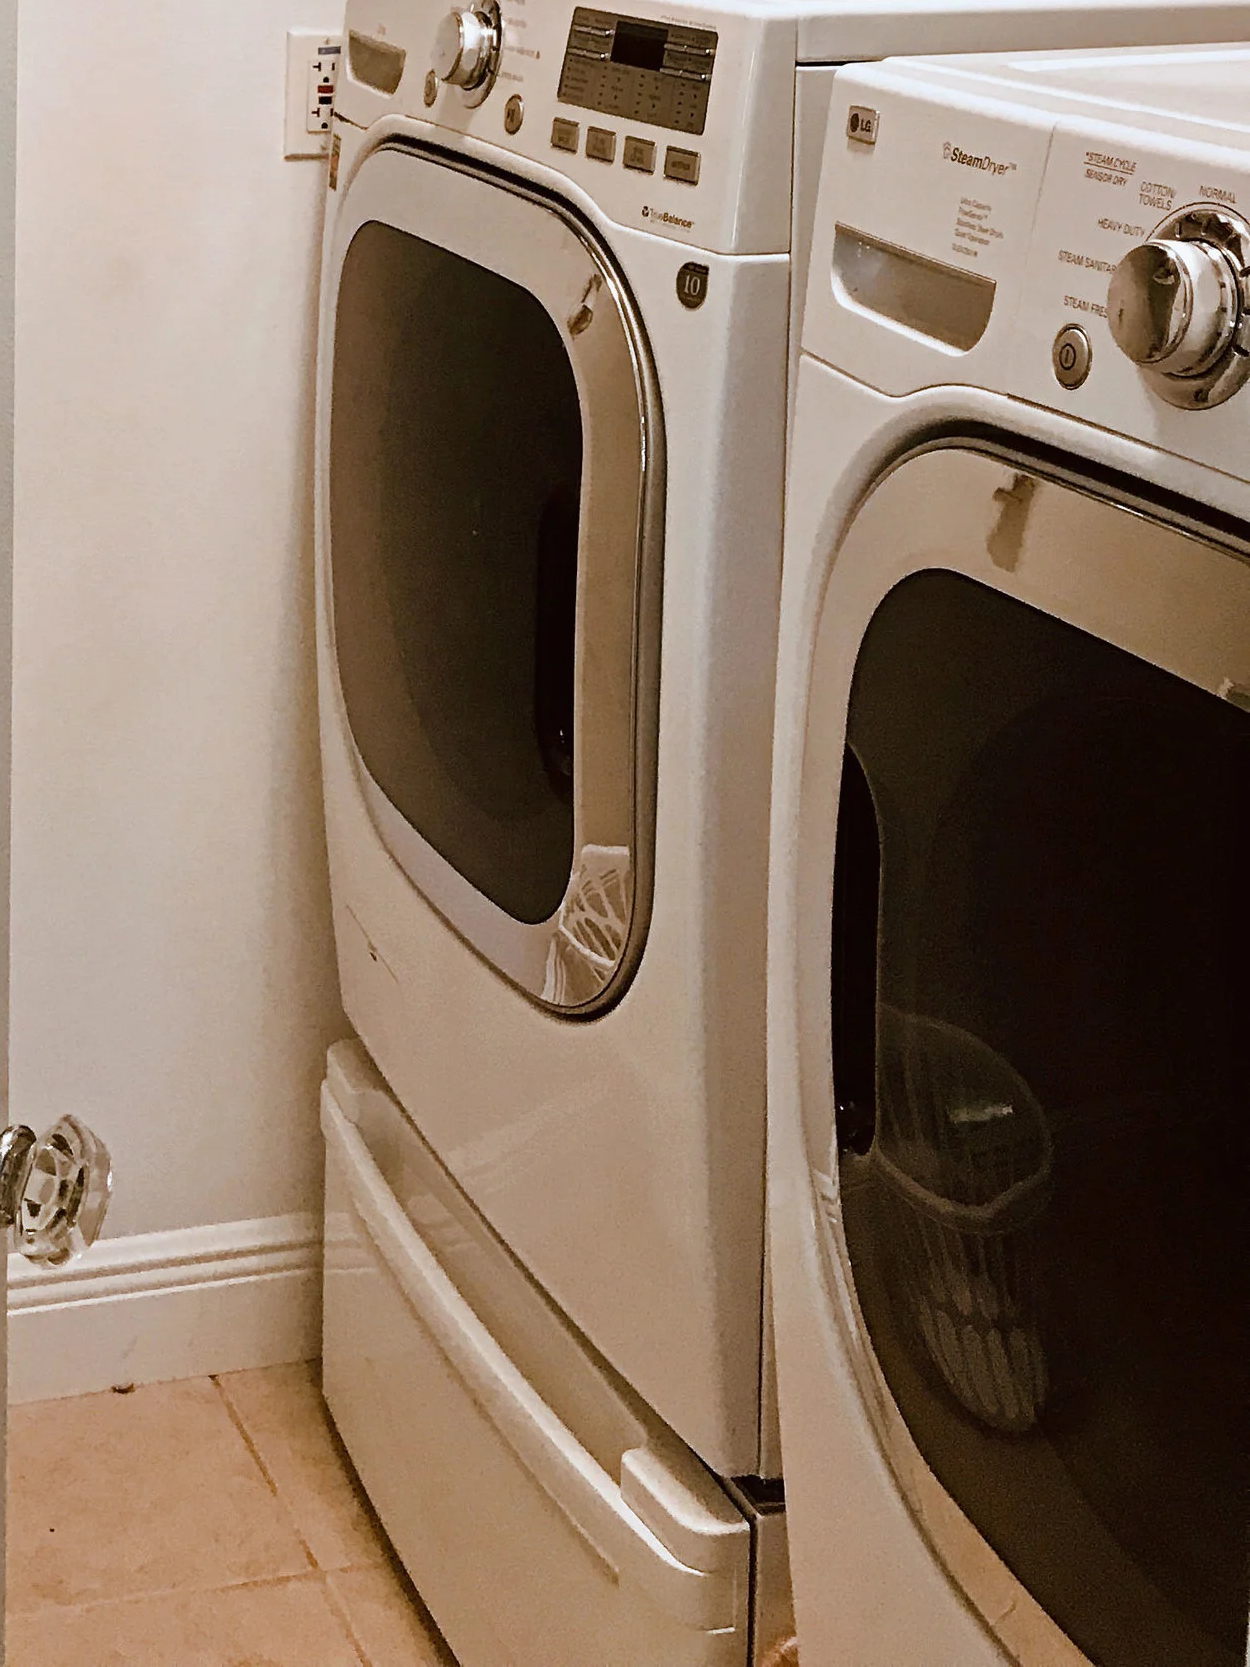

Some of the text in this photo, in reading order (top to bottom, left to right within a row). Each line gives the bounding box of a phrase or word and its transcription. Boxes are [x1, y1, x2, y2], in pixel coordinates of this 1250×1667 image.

[860, 119, 872, 133] LG
[1139, 193, 1172, 211] TOWELS
[1199, 185, 1237, 203] NORMAL
[1098, 218, 1122, 231] HEAVY
[1058, 250, 1084, 266] STEAM
[684, 274, 701, 296] 10
[1063, 295, 1089, 311] STEAM
